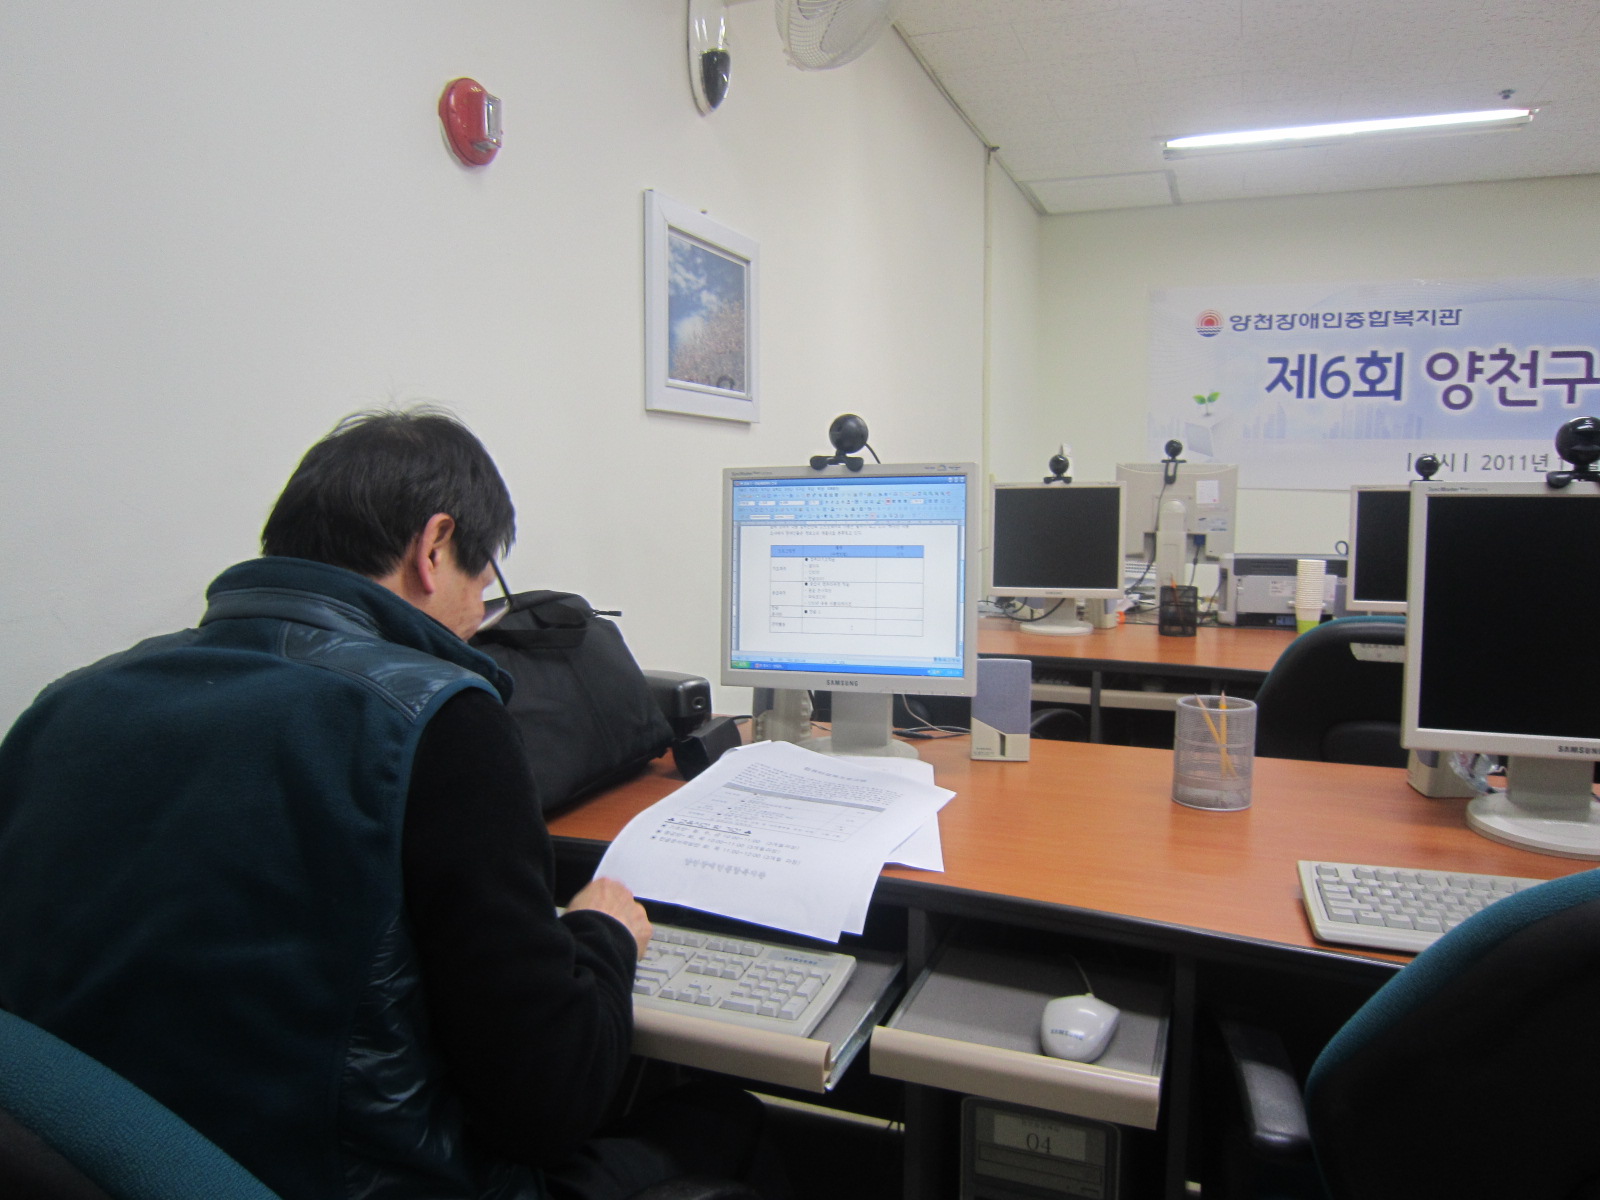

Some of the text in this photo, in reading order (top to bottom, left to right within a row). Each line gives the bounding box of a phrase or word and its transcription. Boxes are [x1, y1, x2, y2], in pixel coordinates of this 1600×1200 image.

[1229, 308, 1463, 332] 양천장애인종합복지관
[1264, 347, 1600, 411] 제6회 양천구
[1481, 452, 1550, 473] 2011년
[826, 679, 859, 687] SAMSUNG
[1026, 1132, 1052, 1154] 04
